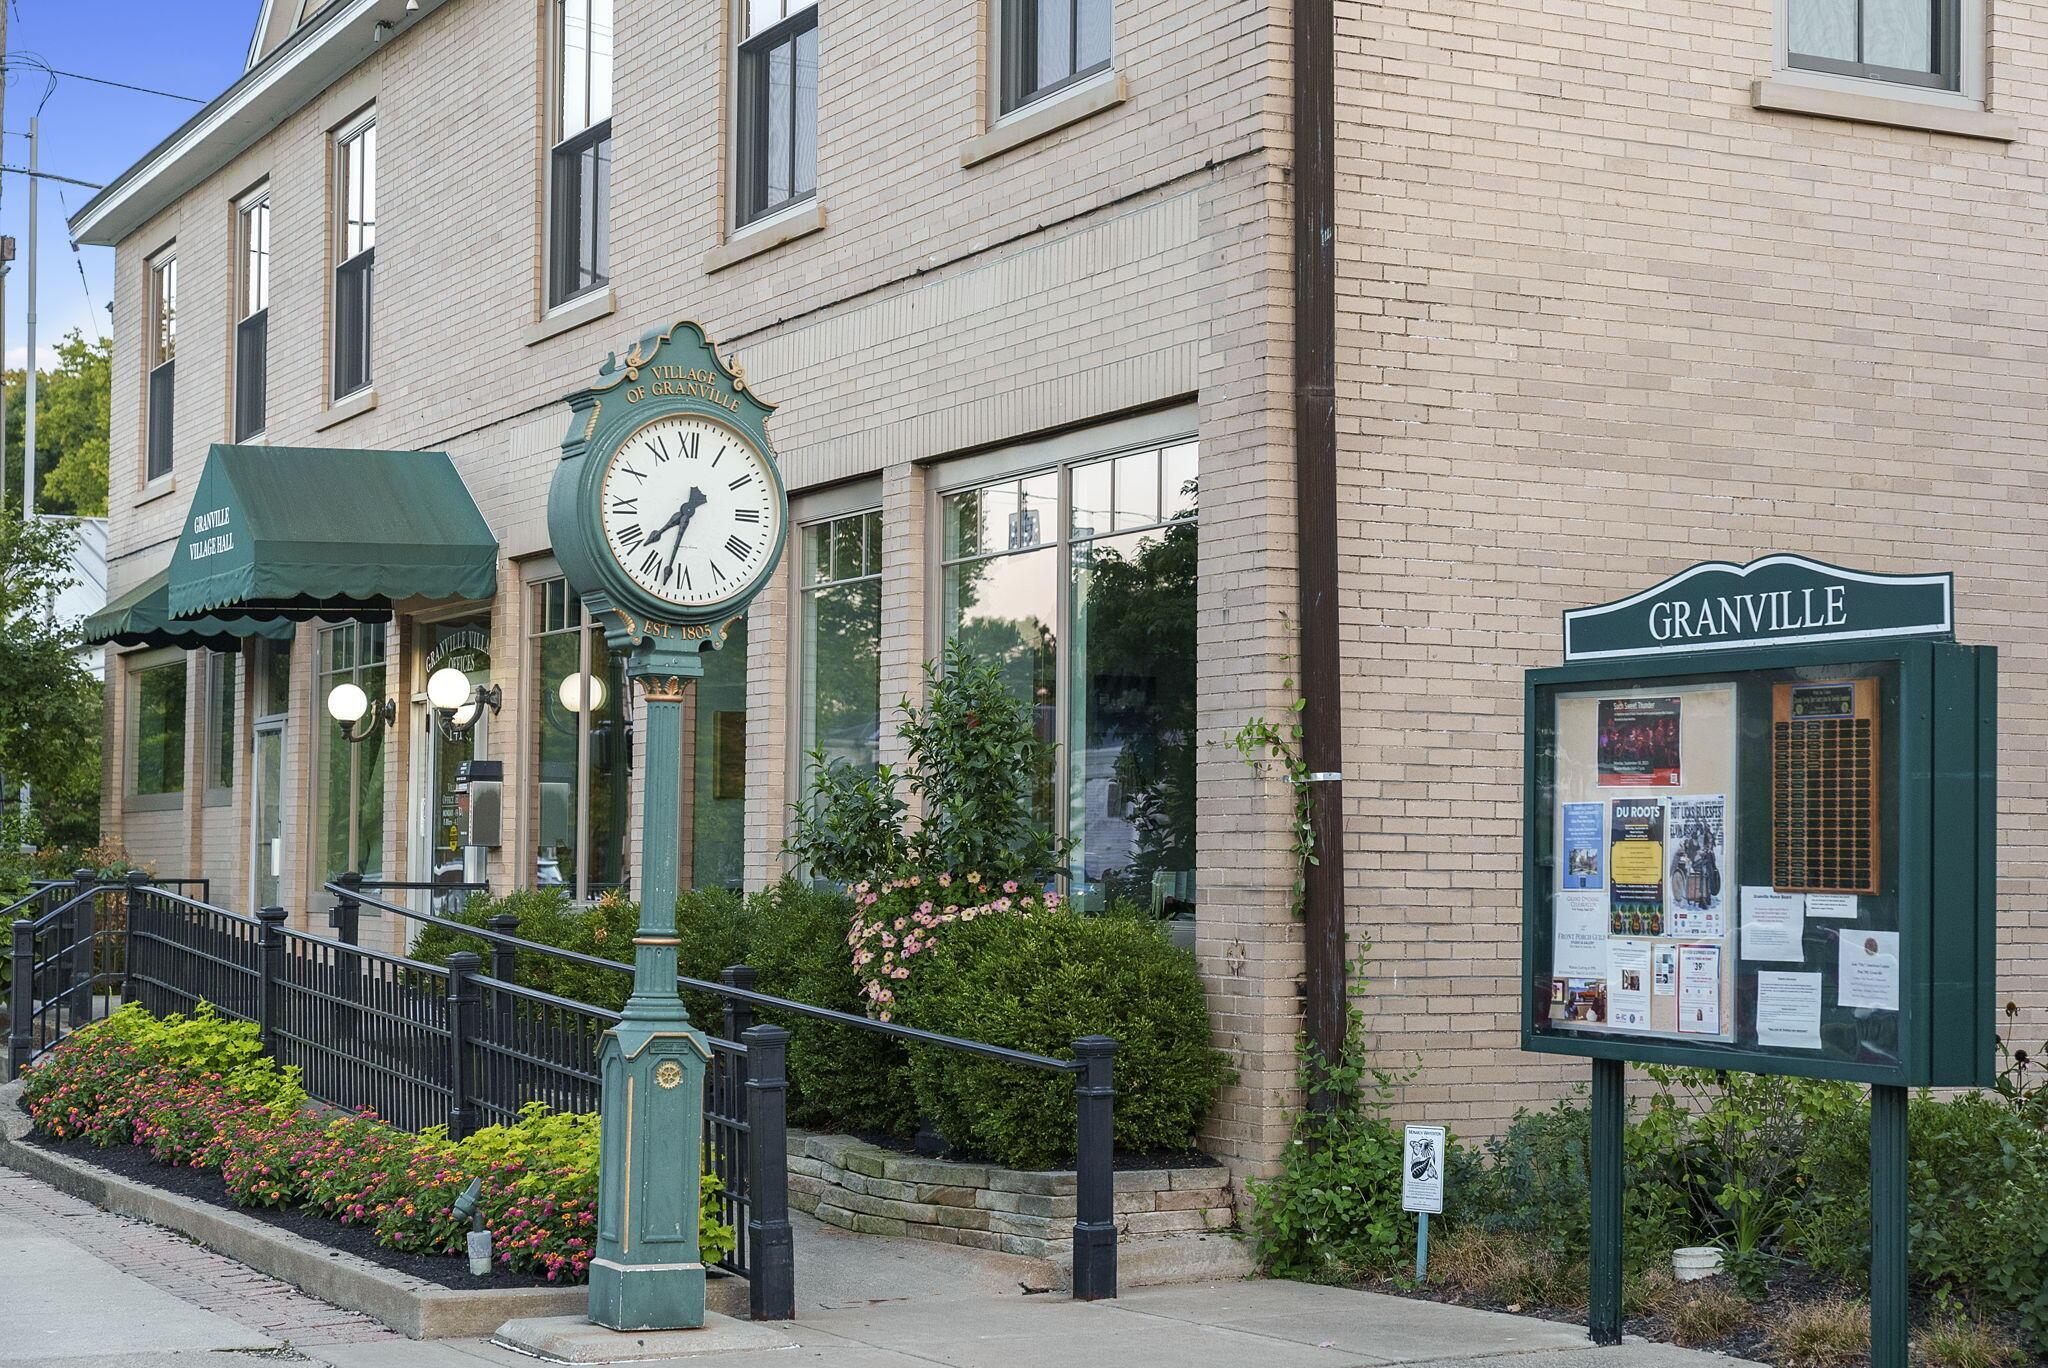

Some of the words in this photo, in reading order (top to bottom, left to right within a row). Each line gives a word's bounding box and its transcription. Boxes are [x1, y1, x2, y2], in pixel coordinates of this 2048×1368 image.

[651, 365, 717, 386] VILLAGE
[626, 386, 645, 405] OF
[651, 381, 741, 413] GRANVILLE
[645, 435, 670, 467] XI
[677, 431, 700, 459] XII
[621, 460, 648, 486] X
[612, 494, 638, 515] IX
[735, 509, 760, 523] III
[194, 506, 230, 534] GRANVILLE
[189, 537, 216, 561] VILLAGE
[216, 532, 235, 553] HALL
[616, 523, 646, 557] VIII
[676, 562, 692, 591] VI
[1649, 585, 1847, 640] GRANVILLE
[643, 620, 674, 639] EST.
[681, 624, 712, 640] 1805
[425, 631, 466, 673] GRANVILLE
[448, 653, 475, 673] OFFICES
[1616, 806, 1629, 818] DU
[1631, 805, 1660, 818] ROOTS
